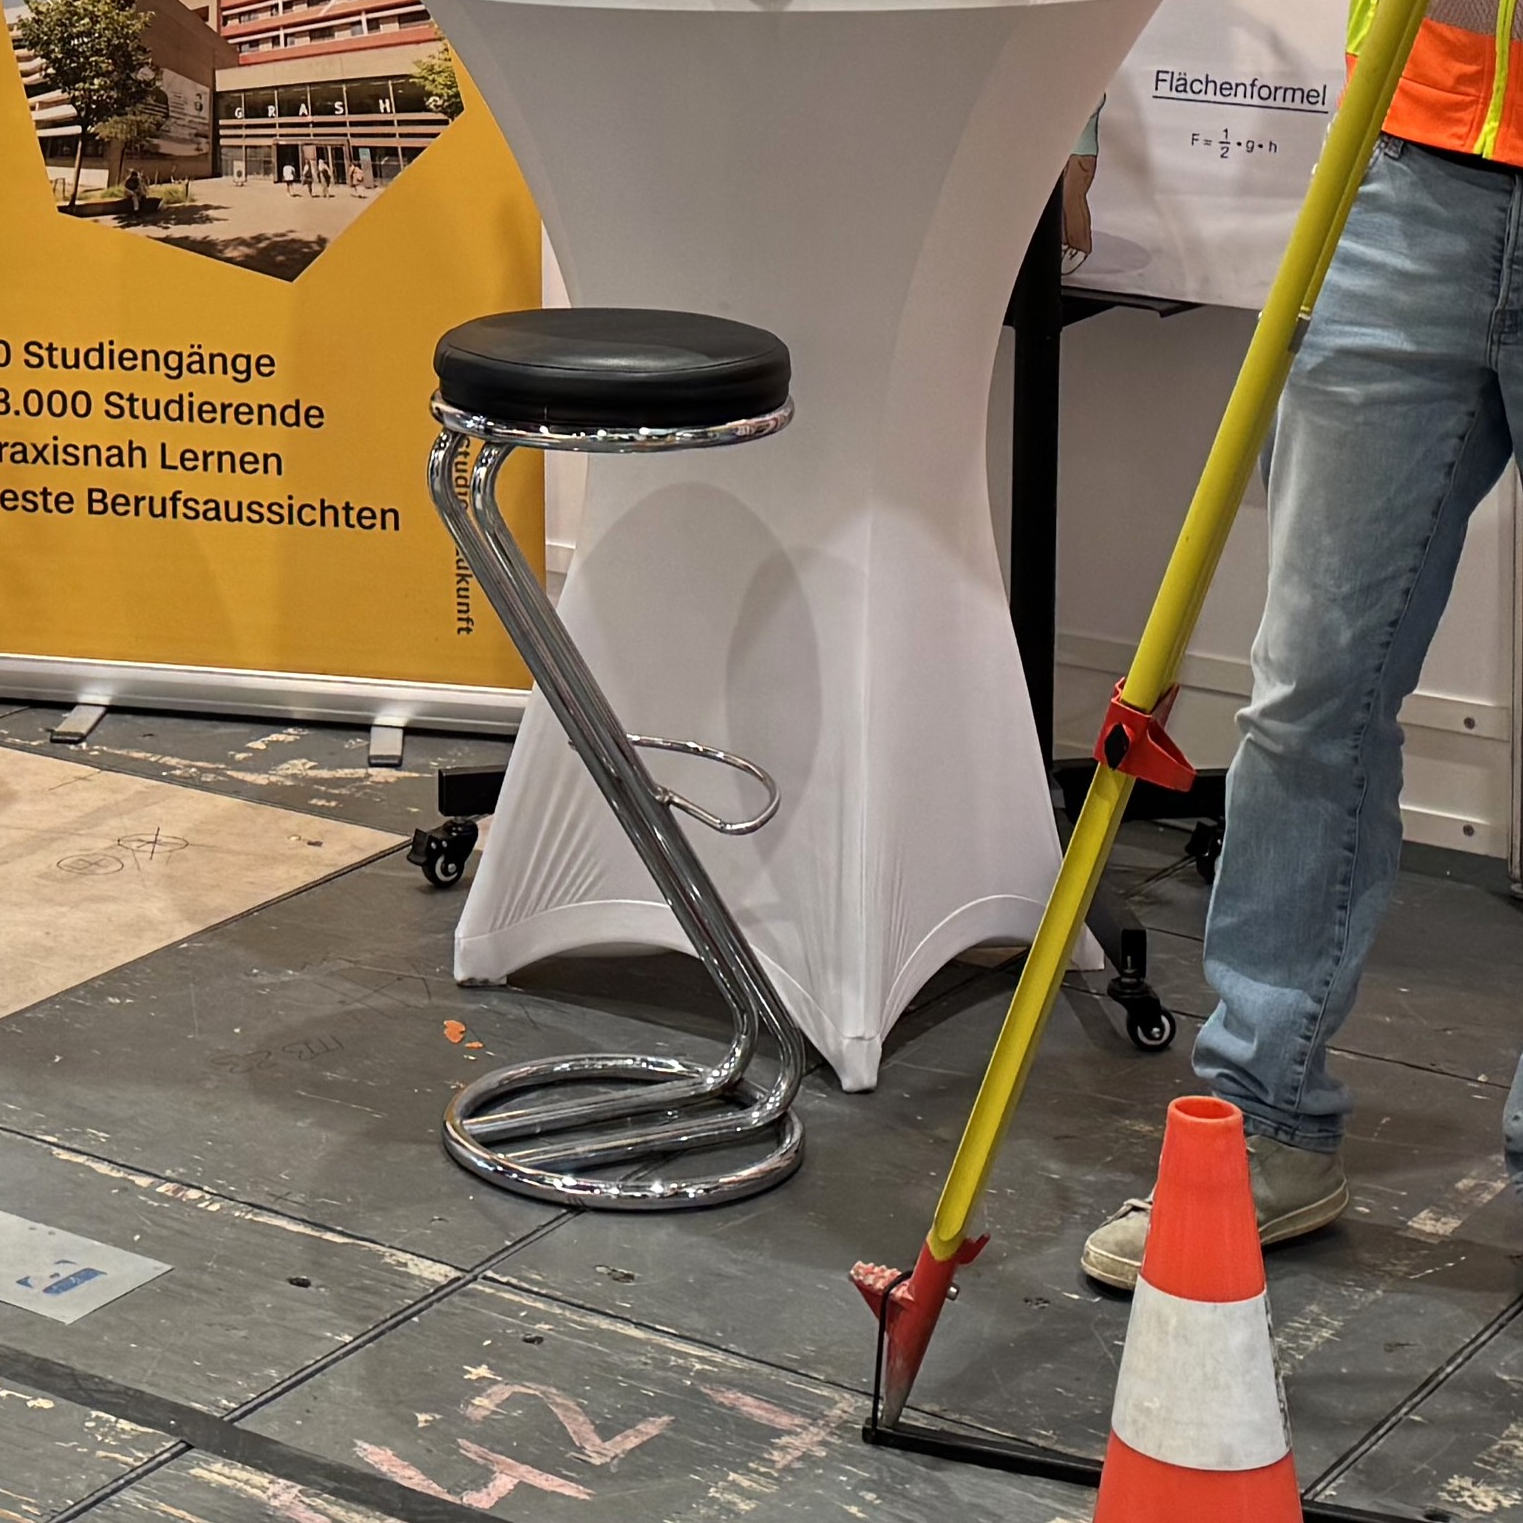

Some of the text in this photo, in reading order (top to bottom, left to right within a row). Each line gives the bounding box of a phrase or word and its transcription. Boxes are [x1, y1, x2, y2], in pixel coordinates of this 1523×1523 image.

[1153, 69, 1328, 107] Flächenformel
[1191, 132, 1201, 147] F
[1245, 139, 1255, 154] g
[1268, 140, 1278, 153] h
[22, 339, 277, 384] Studiengänge
[104, 390, 326, 429] Studierende
[159, 442, 284, 476] Lernen
[85, 486, 401, 532] Berufsaussichten
